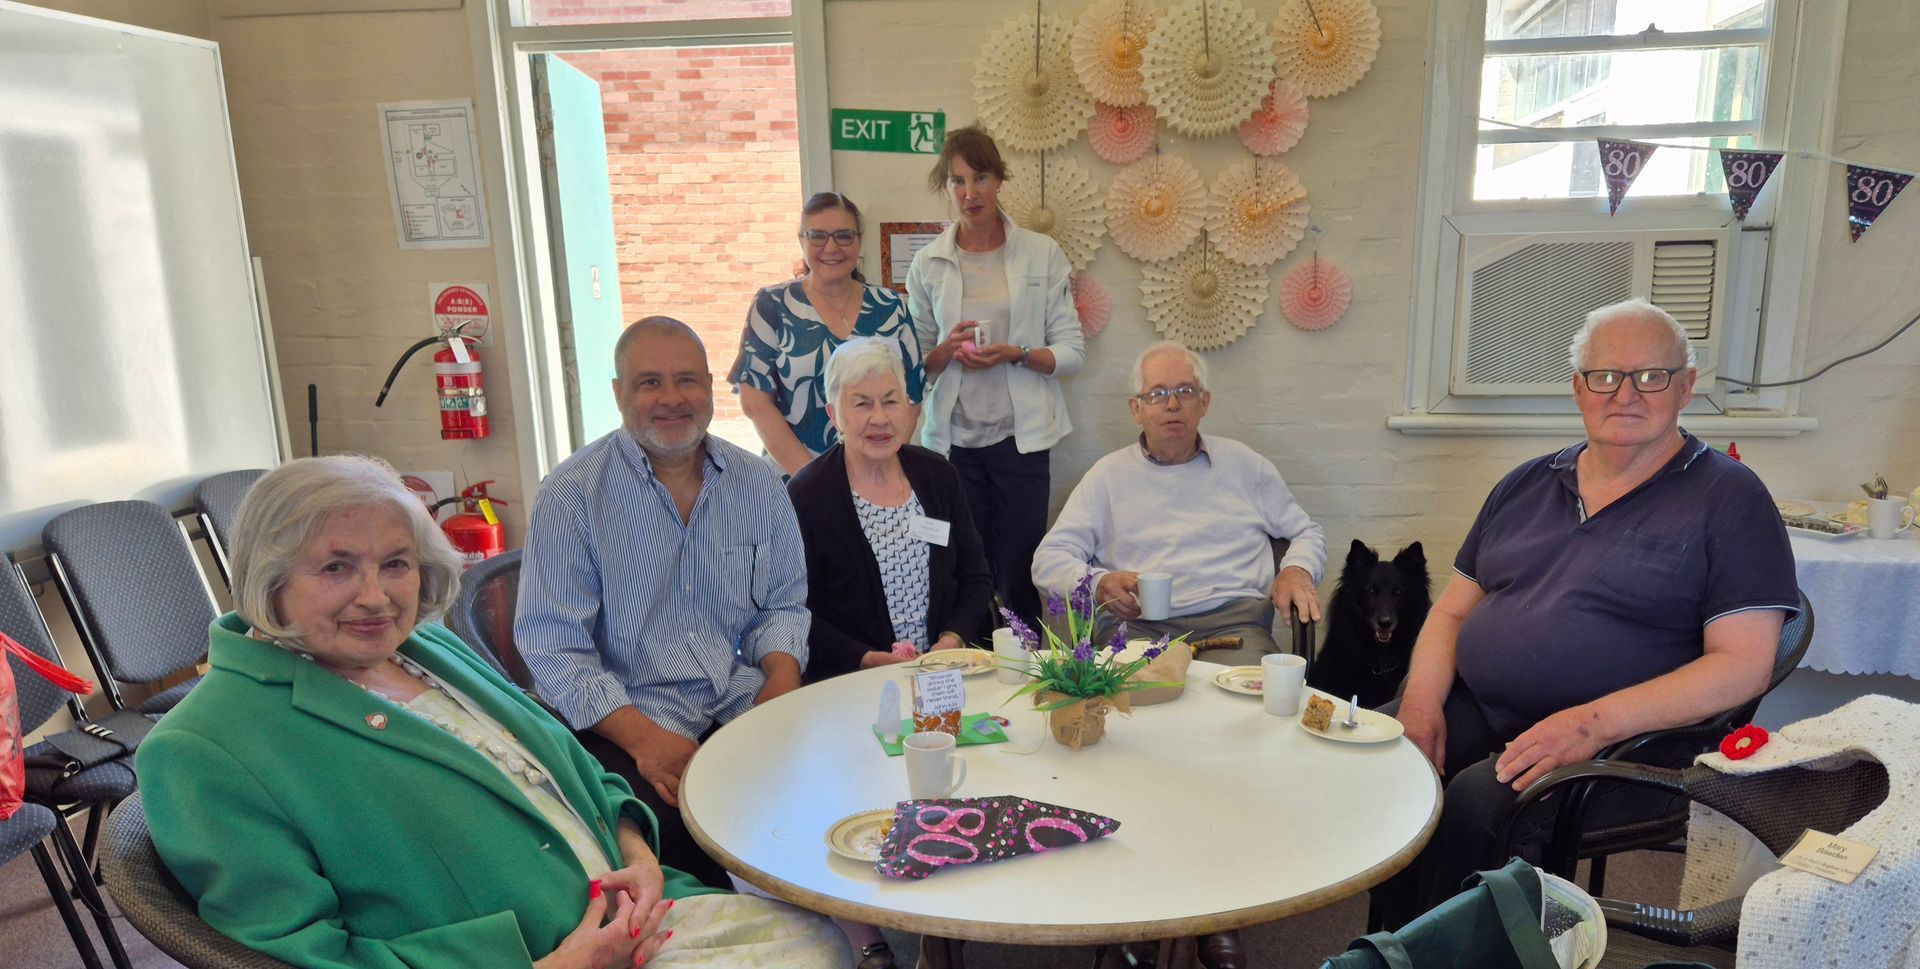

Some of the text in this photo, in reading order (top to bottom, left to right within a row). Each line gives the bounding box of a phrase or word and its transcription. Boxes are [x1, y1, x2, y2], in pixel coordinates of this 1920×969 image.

[841, 118, 891, 140] EXIT
[1605, 149, 1641, 178] 80
[1728, 160, 1767, 188] 80
[1852, 176, 1894, 206] 80
[906, 805, 986, 867] 80
[1827, 842, 1848, 853] Mary
[1816, 847, 1848, 861] Bawden
